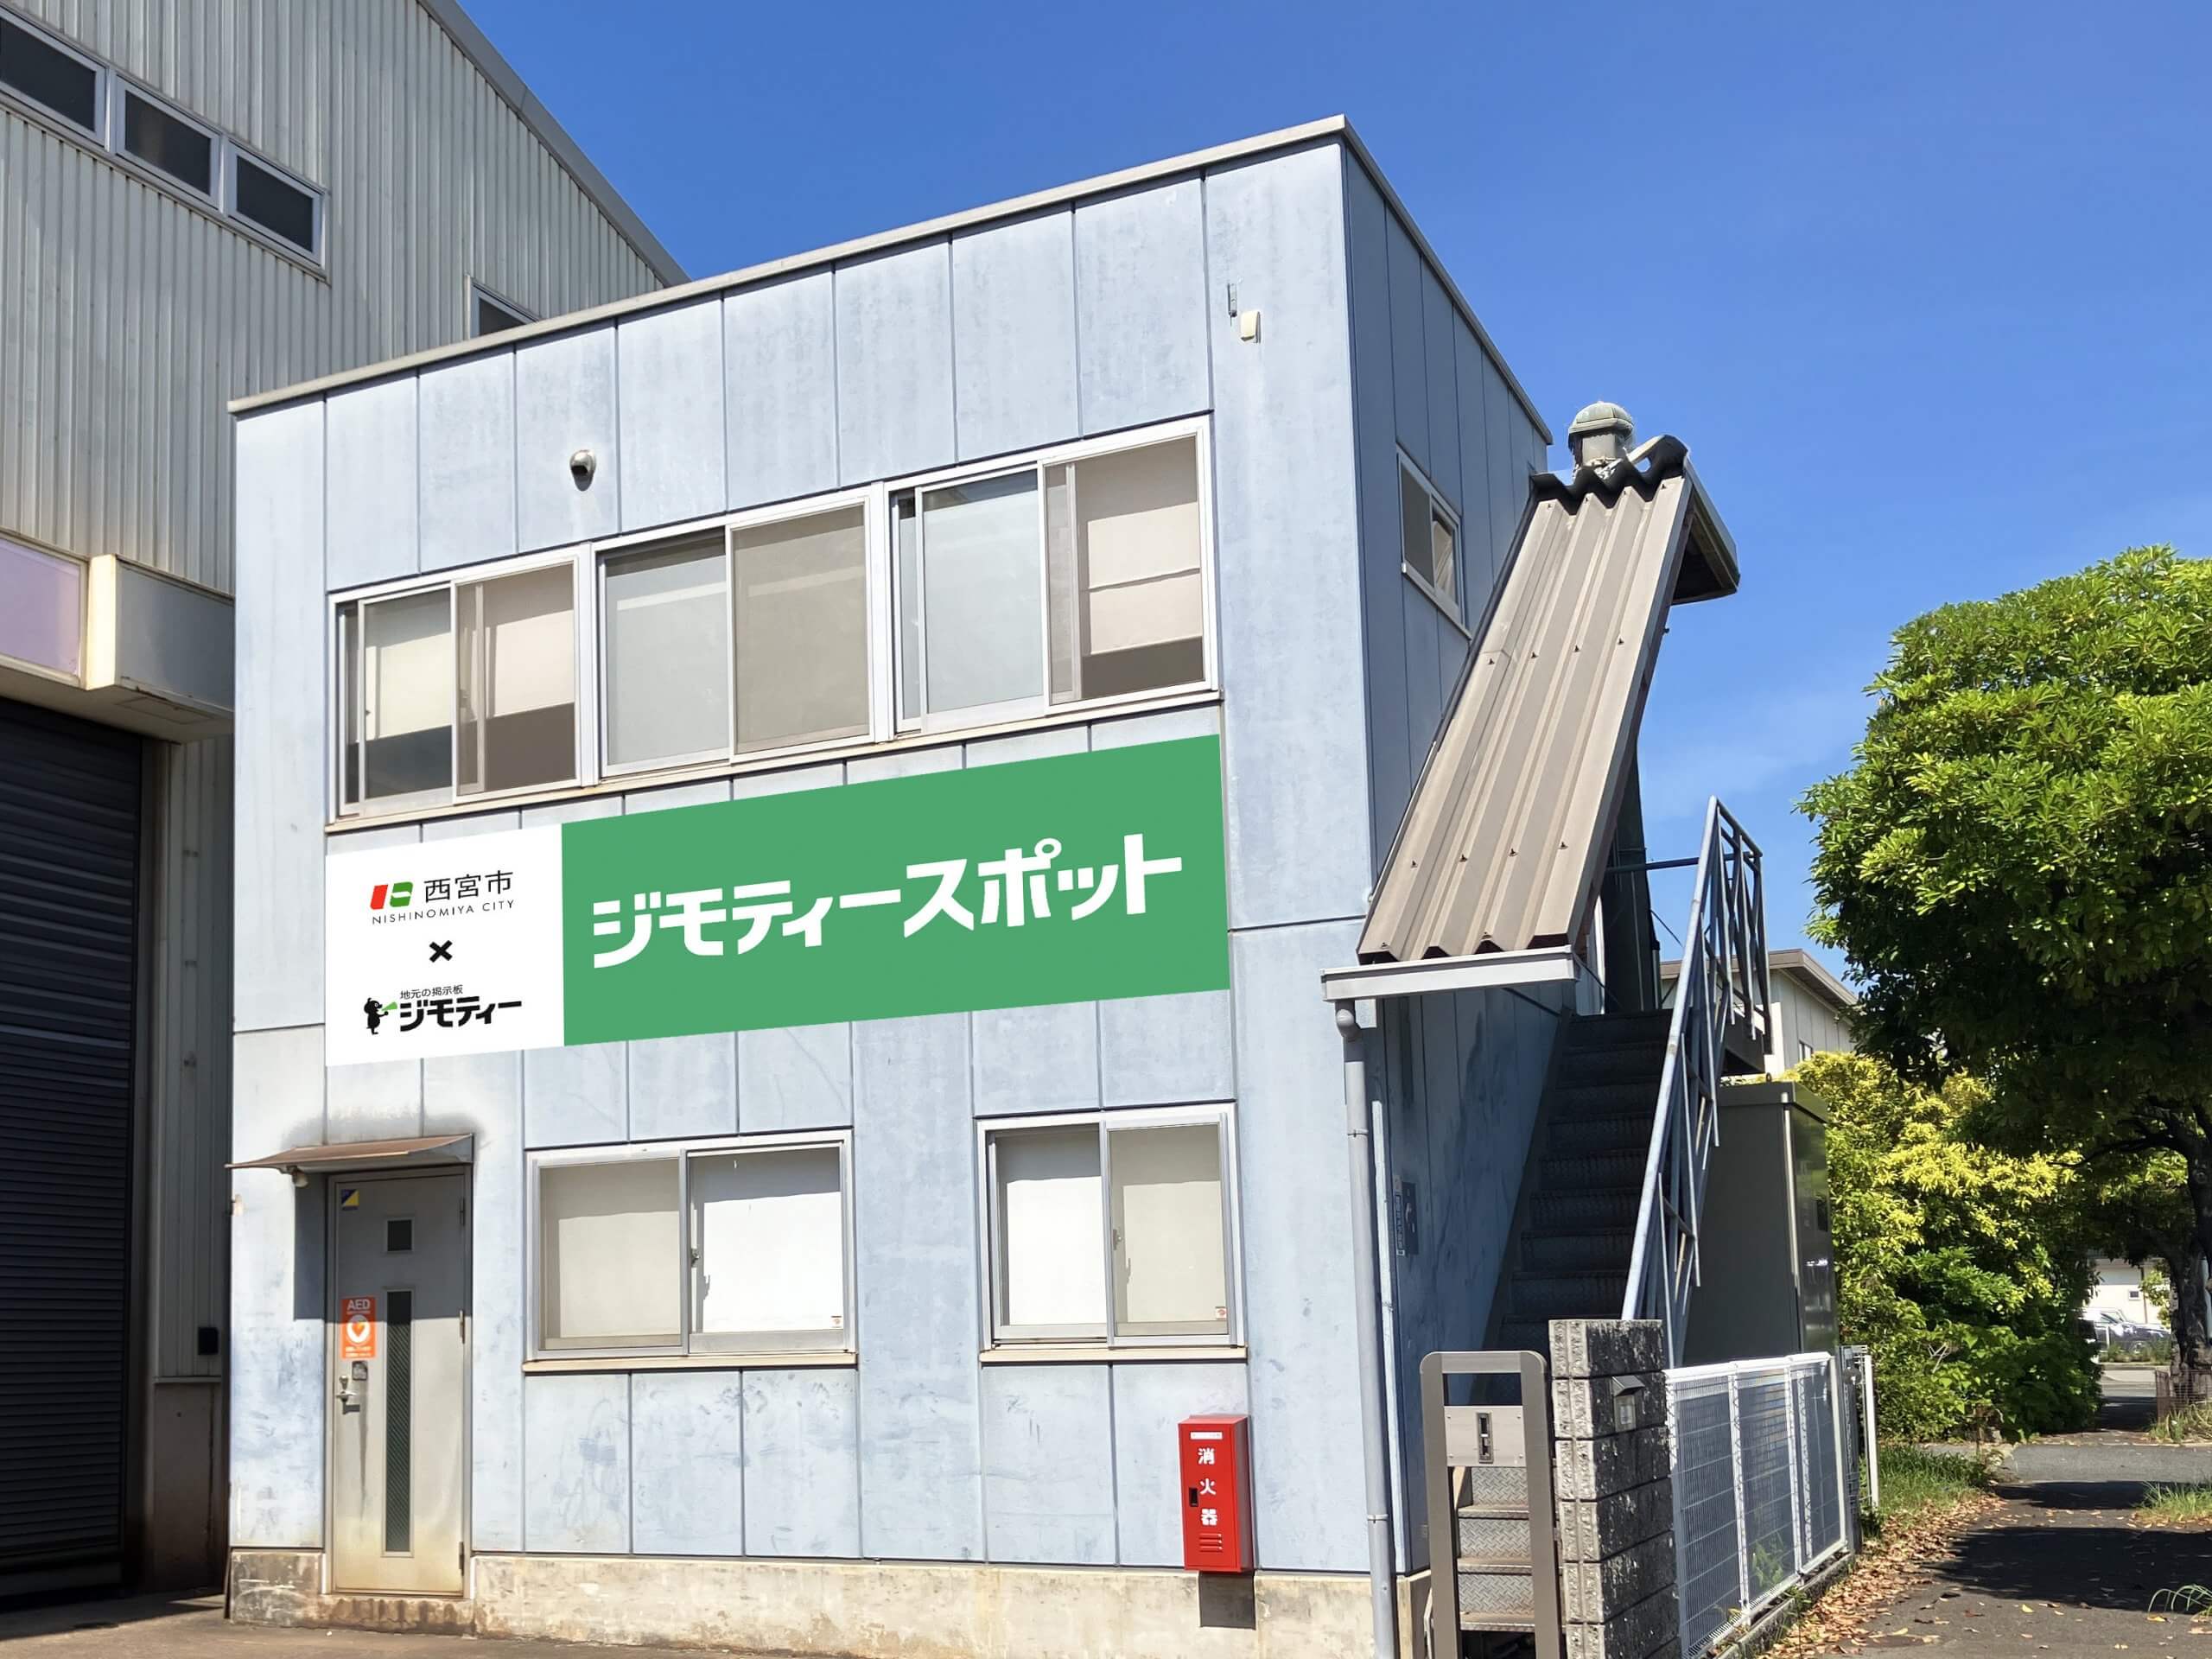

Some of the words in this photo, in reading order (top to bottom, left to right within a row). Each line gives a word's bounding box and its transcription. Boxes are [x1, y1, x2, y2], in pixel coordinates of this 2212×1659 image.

[423, 869, 514, 903] 西宮市
[594, 833, 1183, 969] ジモティースポット
[372, 905, 474, 925] NISHINOMIYA
[482, 899, 515, 912] CITY
[400, 984, 464, 1000] 地元の掲示板
[400, 996, 522, 1032] ジモティー
[347, 1299, 370, 1310] AED
[1198, 1447, 1217, 1525] 消火器
